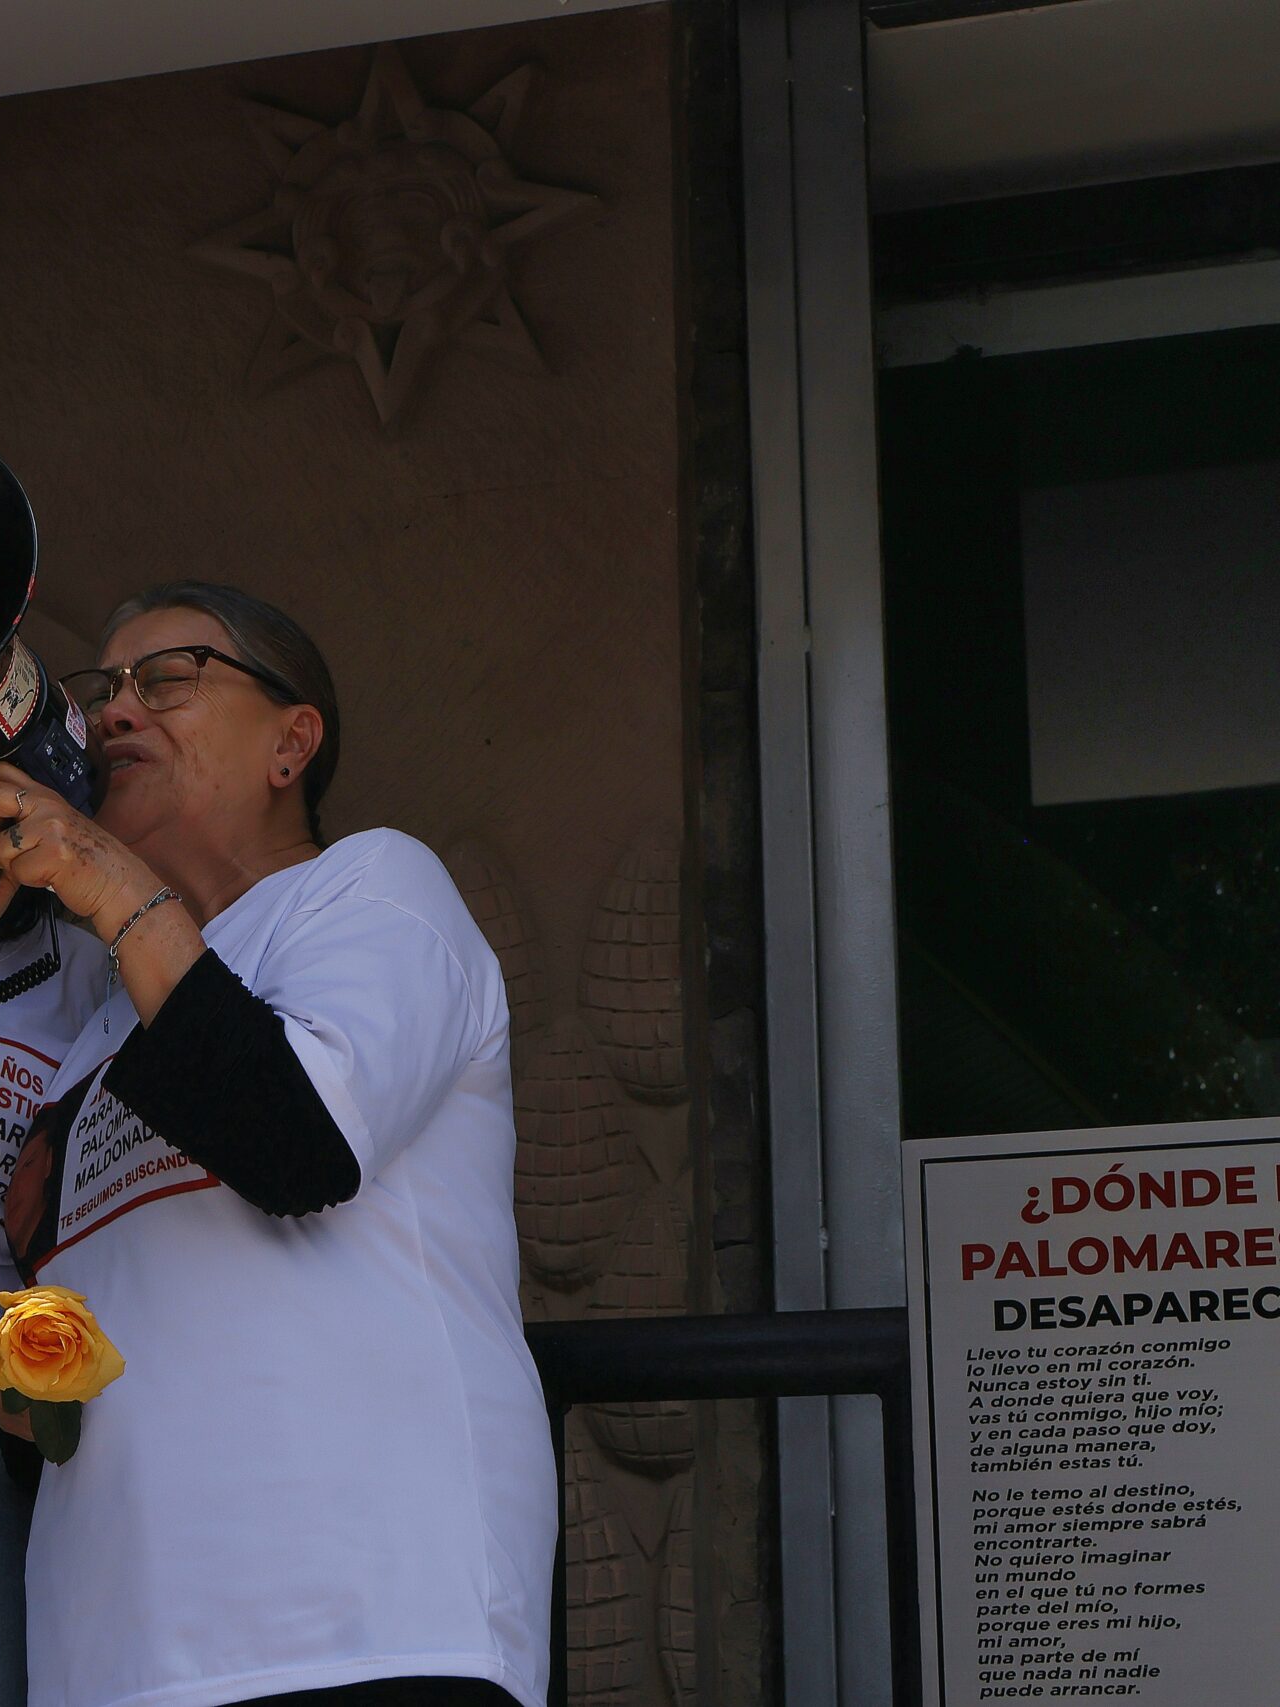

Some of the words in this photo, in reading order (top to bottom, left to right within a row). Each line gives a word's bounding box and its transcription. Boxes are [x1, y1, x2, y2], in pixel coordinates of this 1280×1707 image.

[75, 1096, 113, 1138] PARA
[1020, 1162, 1258, 1225] ¿DÓNDE
[60, 1213, 73, 1230] TE
[75, 1181, 123, 1222] SEGUIMOS
[961, 1228, 1280, 1280] PALOMARE
[994, 1286, 1280, 1331] DESAPAREC
[966, 1348, 1020, 1361] Llevo
[1027, 1347, 1047, 1358] tu
[1054, 1342, 1135, 1357] corazón
[1142, 1338, 1231, 1354] conmigo
[967, 1364, 985, 1378] lo
[991, 1361, 1040, 1376] llevo
[1047, 1363, 1070, 1374] en
[1077, 1359, 1101, 1372] mi
[1108, 1355, 1196, 1371] corazón.
[967, 1379, 1030, 1393] Nunca
[1036, 1377, 1092, 1391] estoy
[1098, 1374, 1126, 1387] sin
[1133, 1373, 1152, 1387] ti.
[969, 1397, 984, 1409] A
[991, 1394, 1054, 1407] donde
[1061, 1391, 1125, 1407] quiera
[1131, 1389, 1170, 1404] que
[1176, 1388, 1219, 1402] voy,
[968, 1413, 1001, 1425] vas
[1008, 1410, 1028, 1423] tú
[1034, 1407, 1128, 1422] conmigo,
[1134, 1405, 1172, 1420] hijo
[1179, 1403, 1224, 1417] mío;
[970, 1430, 982, 1443] y
[988, 1429, 1012, 1441] en
[1018, 1424, 1066, 1439] cada
[1072, 1424, 1120, 1440] paso
[1127, 1422, 1166, 1437] que
[1172, 1420, 1216, 1435] doy,
[970, 1444, 995, 1457] de
[1001, 1441, 1069, 1458] alguna
[1075, 1440, 1156, 1453] manera,
[970, 1458, 1052, 1473] también
[1059, 1456, 1111, 1470] estas
[1117, 1454, 1143, 1468] tú.
[972, 1489, 1000, 1502] No
[1007, 1488, 1024, 1501] le
[1031, 1487, 1083, 1500] temo
[1090, 1485, 1107, 1499] al
[1113, 1483, 1195, 1498] destino,
[973, 1505, 1046, 1521] porque
[1052, 1502, 1105, 1516] estés
[1111, 1499, 1176, 1514] donde
[1183, 1497, 1242, 1512] estés,
[973, 1522, 997, 1534] mi
[1004, 1521, 1057, 1534] amor
[1062, 1518, 1144, 1533] siempre
[1150, 1514, 1207, 1529] sabrá
[973, 1536, 1098, 1551] encontrarte.
[974, 1555, 1003, 1567] No
[1009, 1553, 1074, 1568] quiero
[1081, 1550, 1171, 1565] imaginar
[975, 1571, 999, 1583] un
[1006, 1568, 1076, 1583] mundo
[976, 1589, 999, 1599] en
[1006, 1586, 1024, 1598] el
[1030, 1587, 1068, 1601] que
[1075, 1583, 1095, 1597] tú
[1102, 1585, 1127, 1596] no
[1134, 1582, 1206, 1596] formes
[977, 1603, 1031, 1618] parte
[1037, 1601, 1068, 1614] del
[1075, 1600, 1119, 1614] mío,
[977, 1619, 1050, 1634] porque
[1057, 1618, 1100, 1630] eres
[1106, 1616, 1131, 1629] mi
[1138, 1615, 1181, 1630] hijo,
[978, 1636, 1002, 1648] mi
[1008, 1636, 1066, 1649] amor,
[978, 1653, 1014, 1665] una
[1020, 1651, 1074, 1666] parte
[1081, 1649, 1107, 1663] de
[1113, 1648, 1140, 1661] mí
[978, 1670, 1016, 1683] que
[1022, 1667, 1072, 1680] nada
[1079, 1666, 1098, 1679] ni
[1104, 1665, 1161, 1678] nadie
[980, 1684, 1044, 1699] puede
[1050, 1683, 1141, 1697] arrancar.
